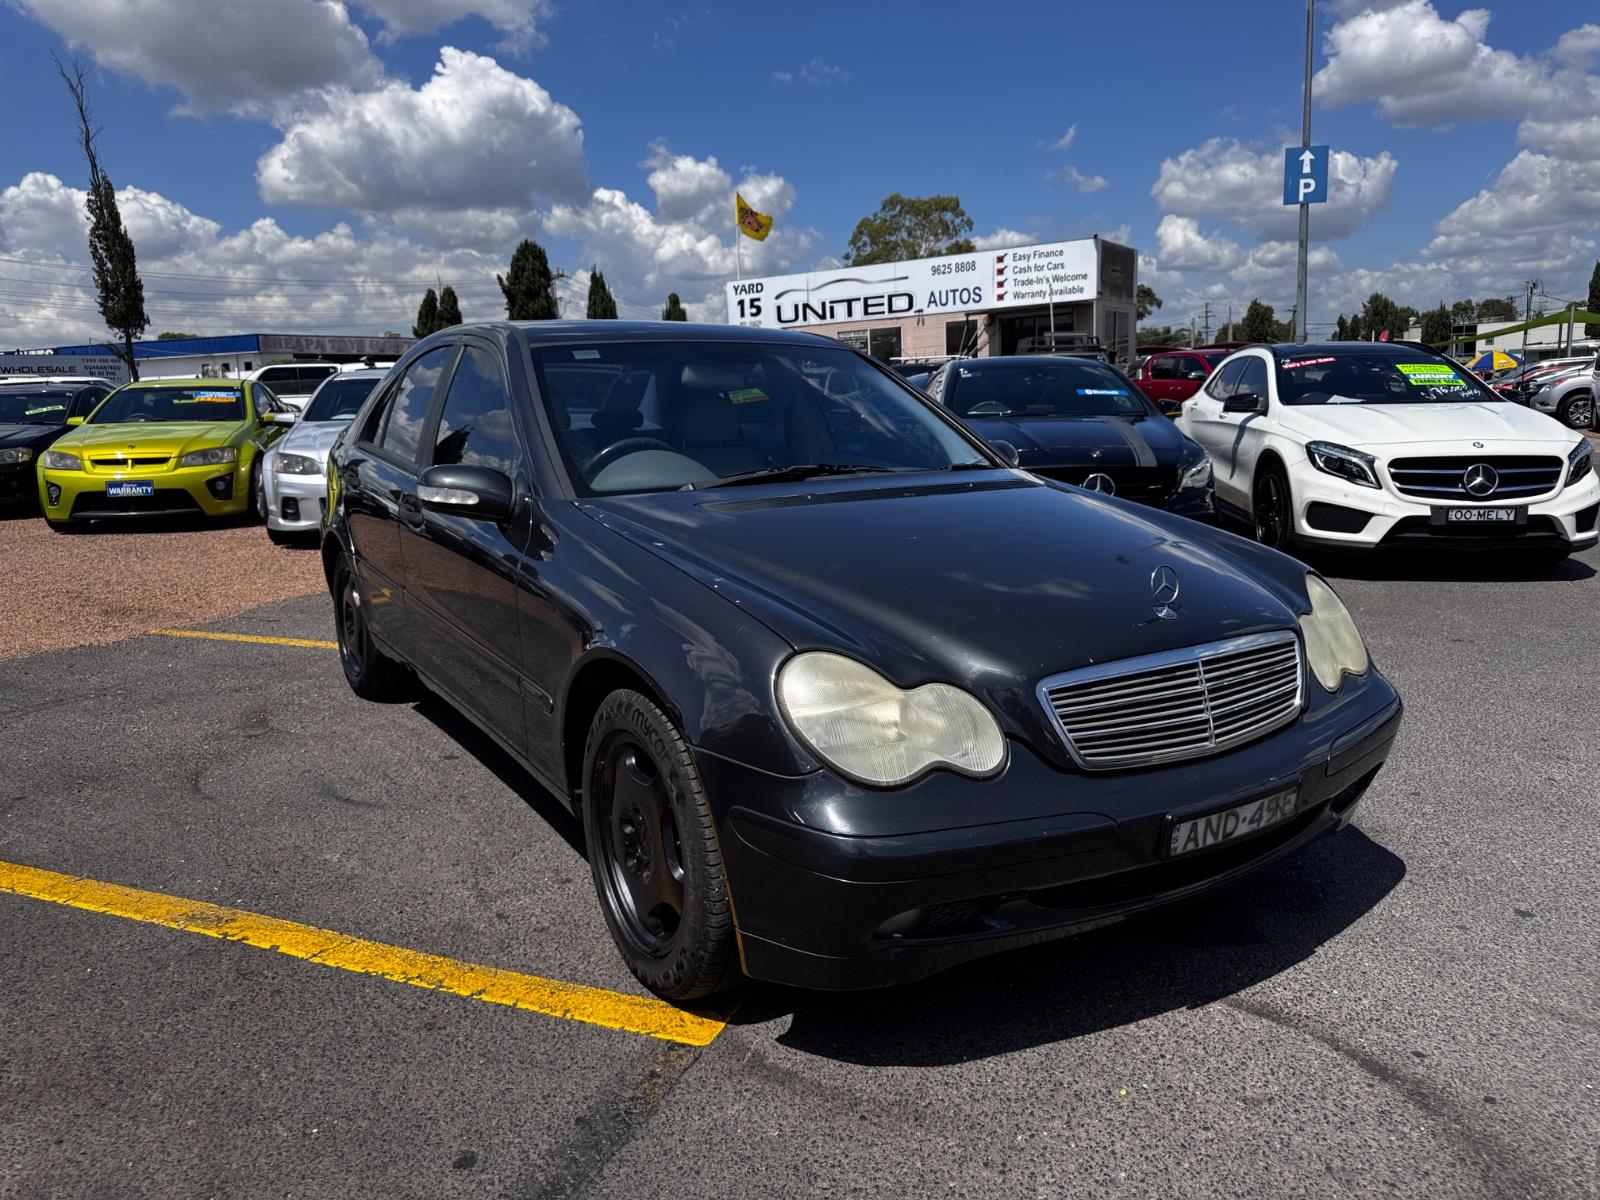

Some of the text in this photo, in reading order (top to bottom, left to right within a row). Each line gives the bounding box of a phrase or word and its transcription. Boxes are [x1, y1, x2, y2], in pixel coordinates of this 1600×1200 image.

[1299, 178, 1316, 202] P
[1012, 249, 1064, 263] Easy Finance
[931, 260, 976, 276] 9625 8808
[1012, 262, 1065, 275] Cash for Cars
[1013, 272, 1088, 288] Trade-In's Welcome
[733, 282, 764, 296] YARD
[927, 286, 983, 308] AUTOS
[1012, 285, 1085, 301] Warranty Available
[737, 297, 762, 318] 15
[0, 365, 77, 375] WHOLESALE
[108, 486, 153, 495] WARRANTY
